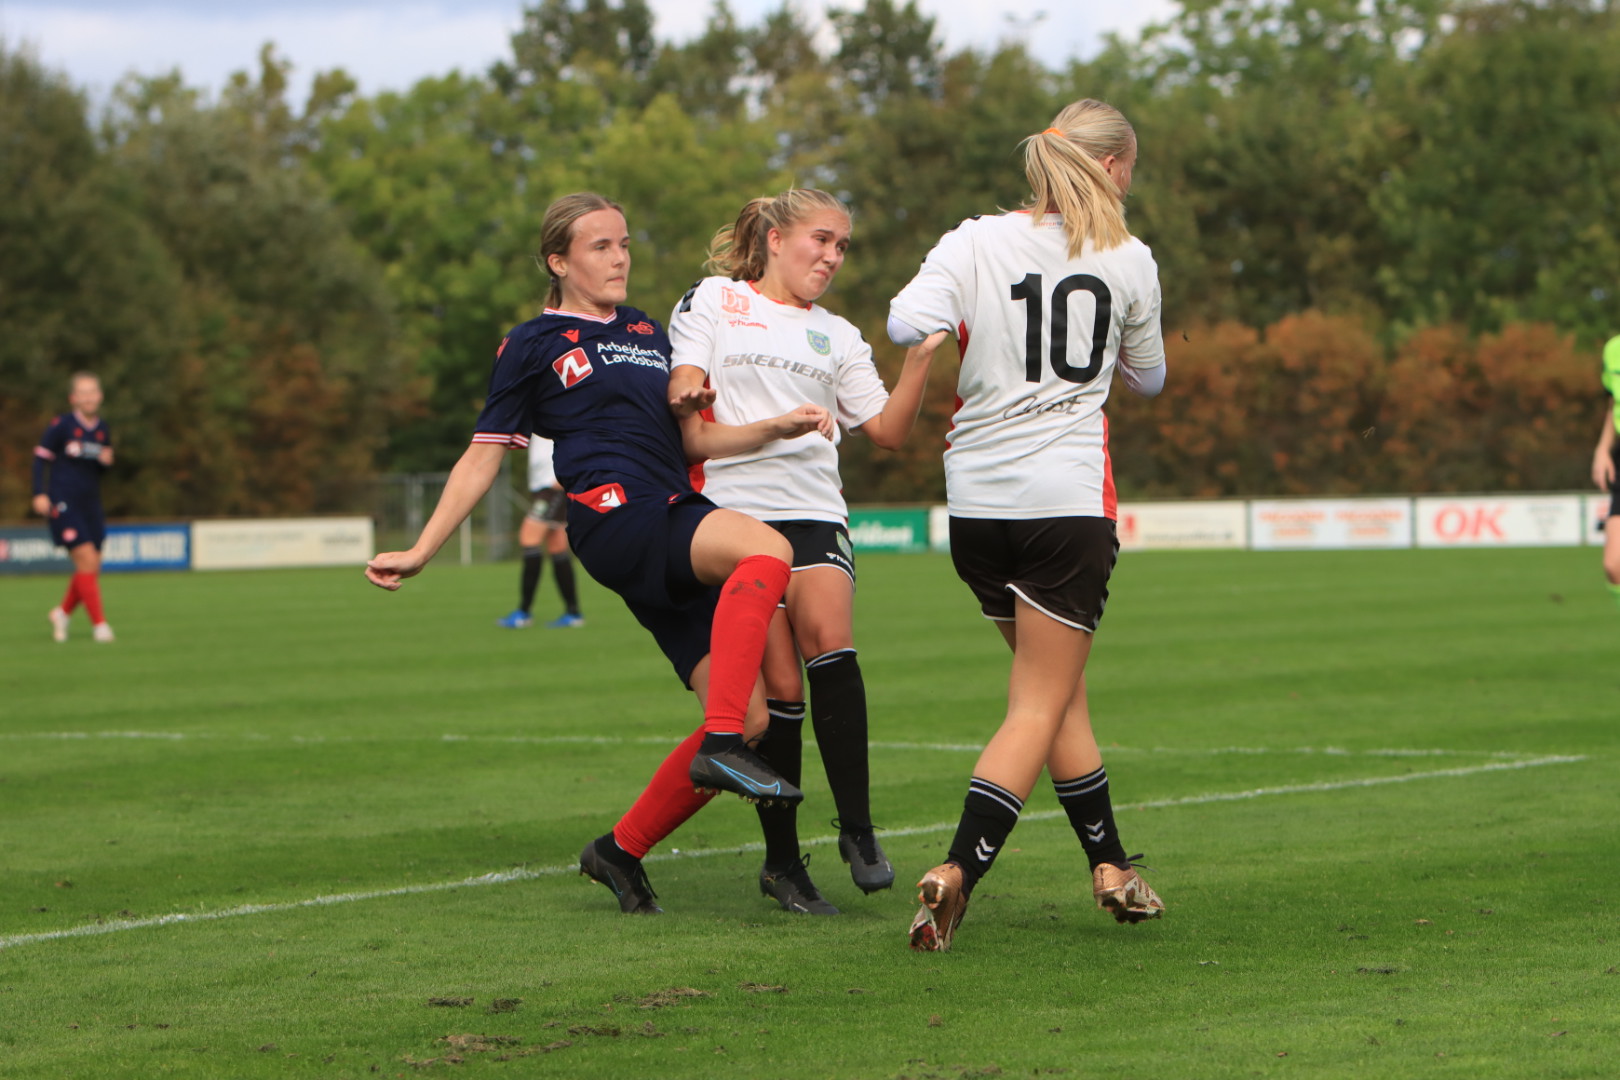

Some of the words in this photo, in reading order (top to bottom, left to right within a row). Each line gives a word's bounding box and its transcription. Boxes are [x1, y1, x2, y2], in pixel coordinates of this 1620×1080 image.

[1010, 272, 1112, 384] 10
[722, 353, 834, 386] SKECHERS
[1433, 503, 1507, 543] OK
